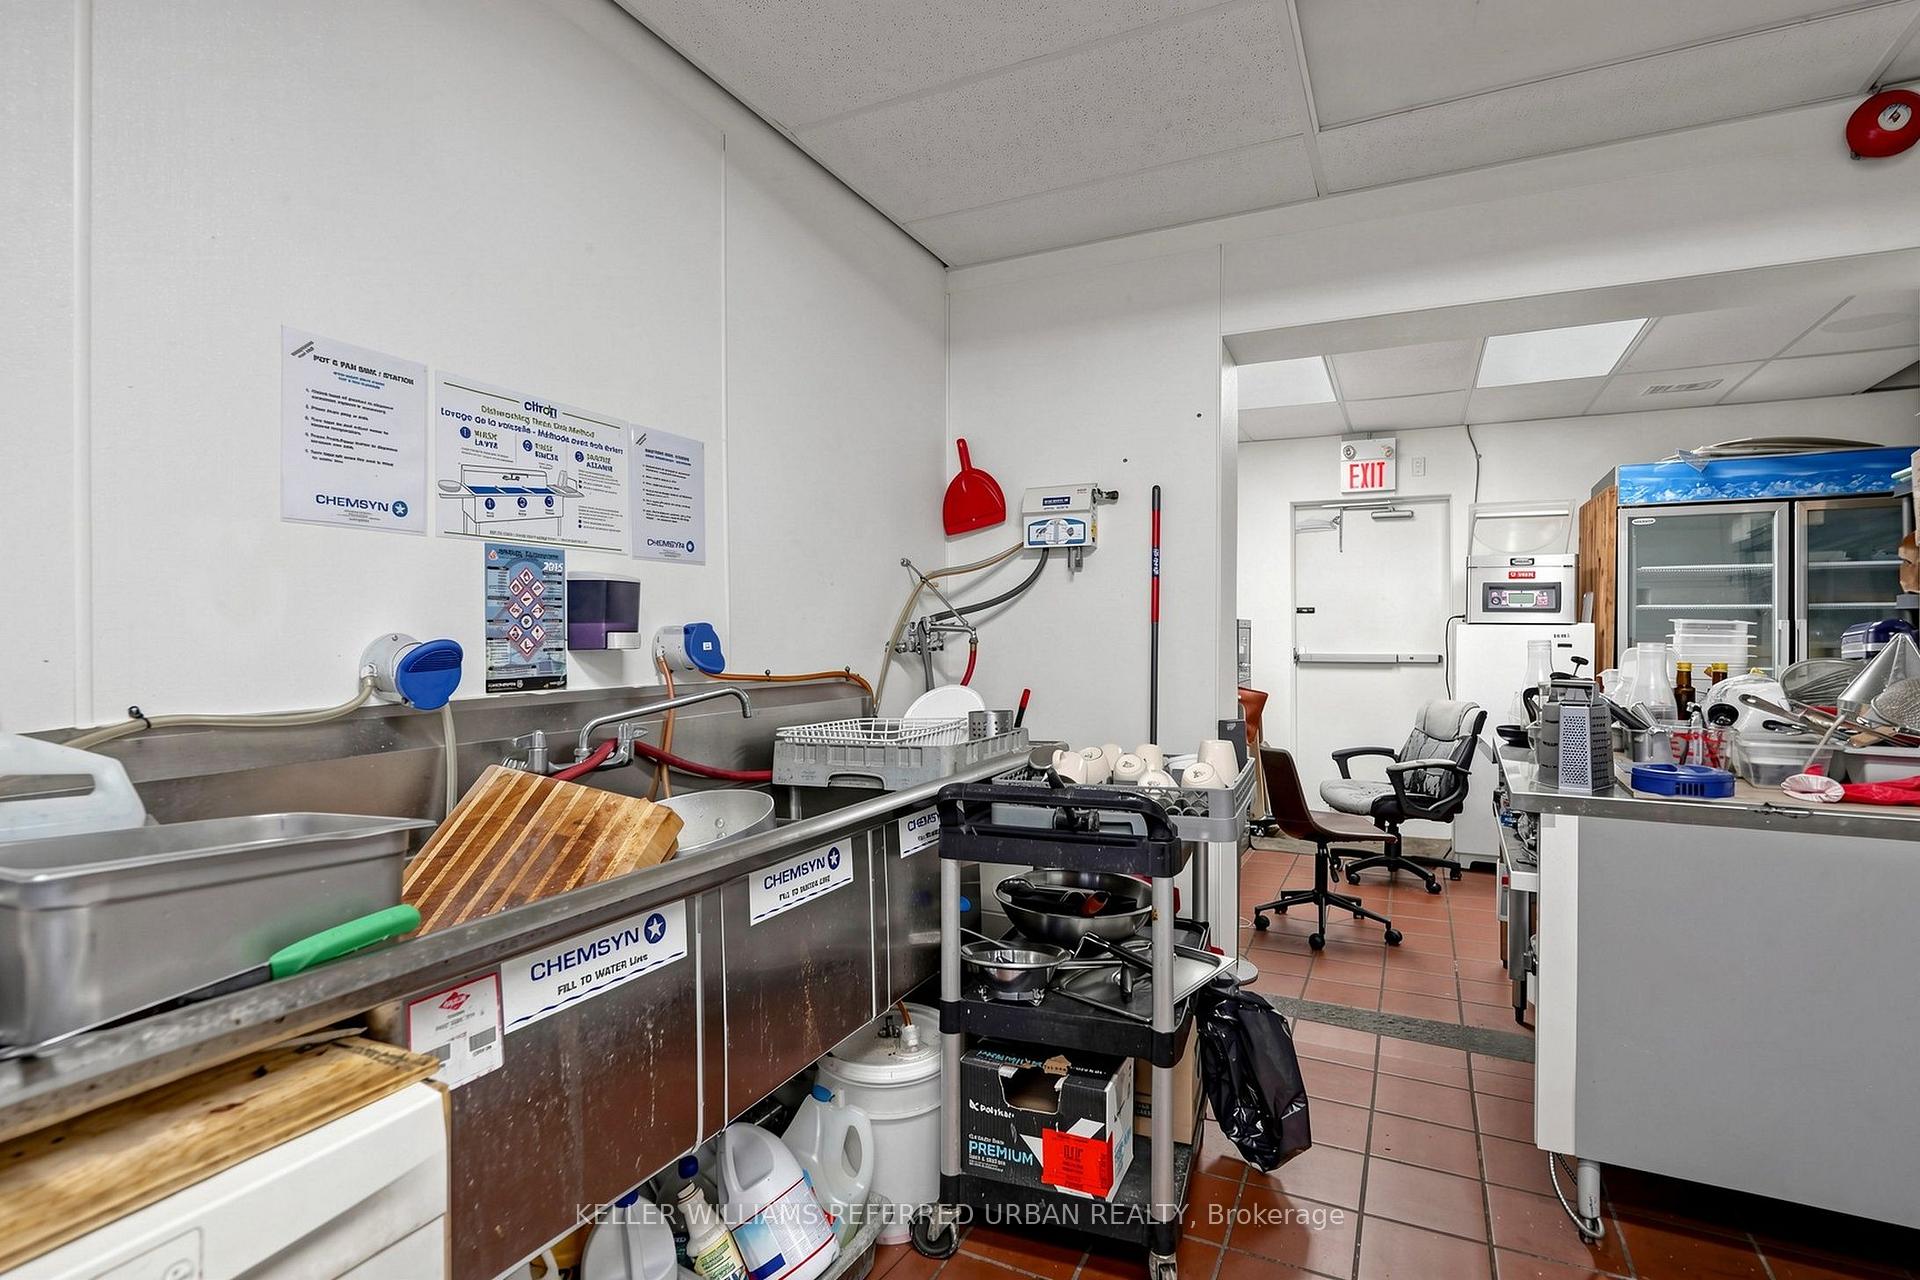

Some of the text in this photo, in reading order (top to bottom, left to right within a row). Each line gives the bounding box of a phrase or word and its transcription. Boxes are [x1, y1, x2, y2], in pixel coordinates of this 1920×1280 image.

[1349, 462, 1385, 489] EXIT
[315, 494, 389, 512] CHEMSYN
[764, 856, 826, 890] CHEMSYN
[530, 927, 640, 981] CHEMSYN
[557, 981, 577, 995] FILL
[580, 973, 592, 985] TO
[595, 960, 627, 981] WATER
[969, 1140, 1033, 1166] PREMIUM
